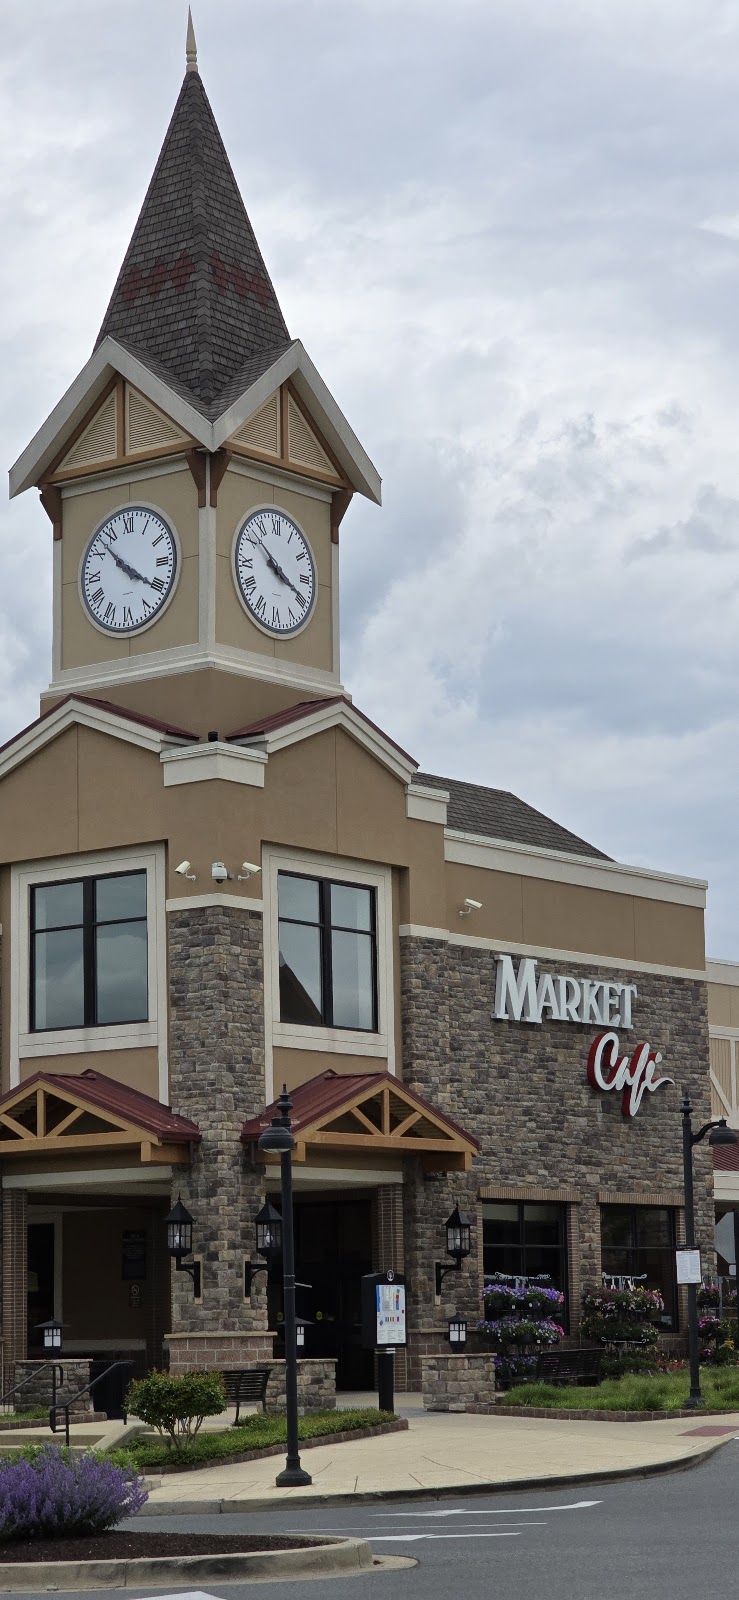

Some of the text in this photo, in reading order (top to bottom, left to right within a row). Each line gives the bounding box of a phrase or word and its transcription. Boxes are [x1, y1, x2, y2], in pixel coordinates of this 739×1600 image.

[156, 556, 169, 567] III
[300, 574, 309, 585] III
[491, 954, 638, 1029] MARKET
